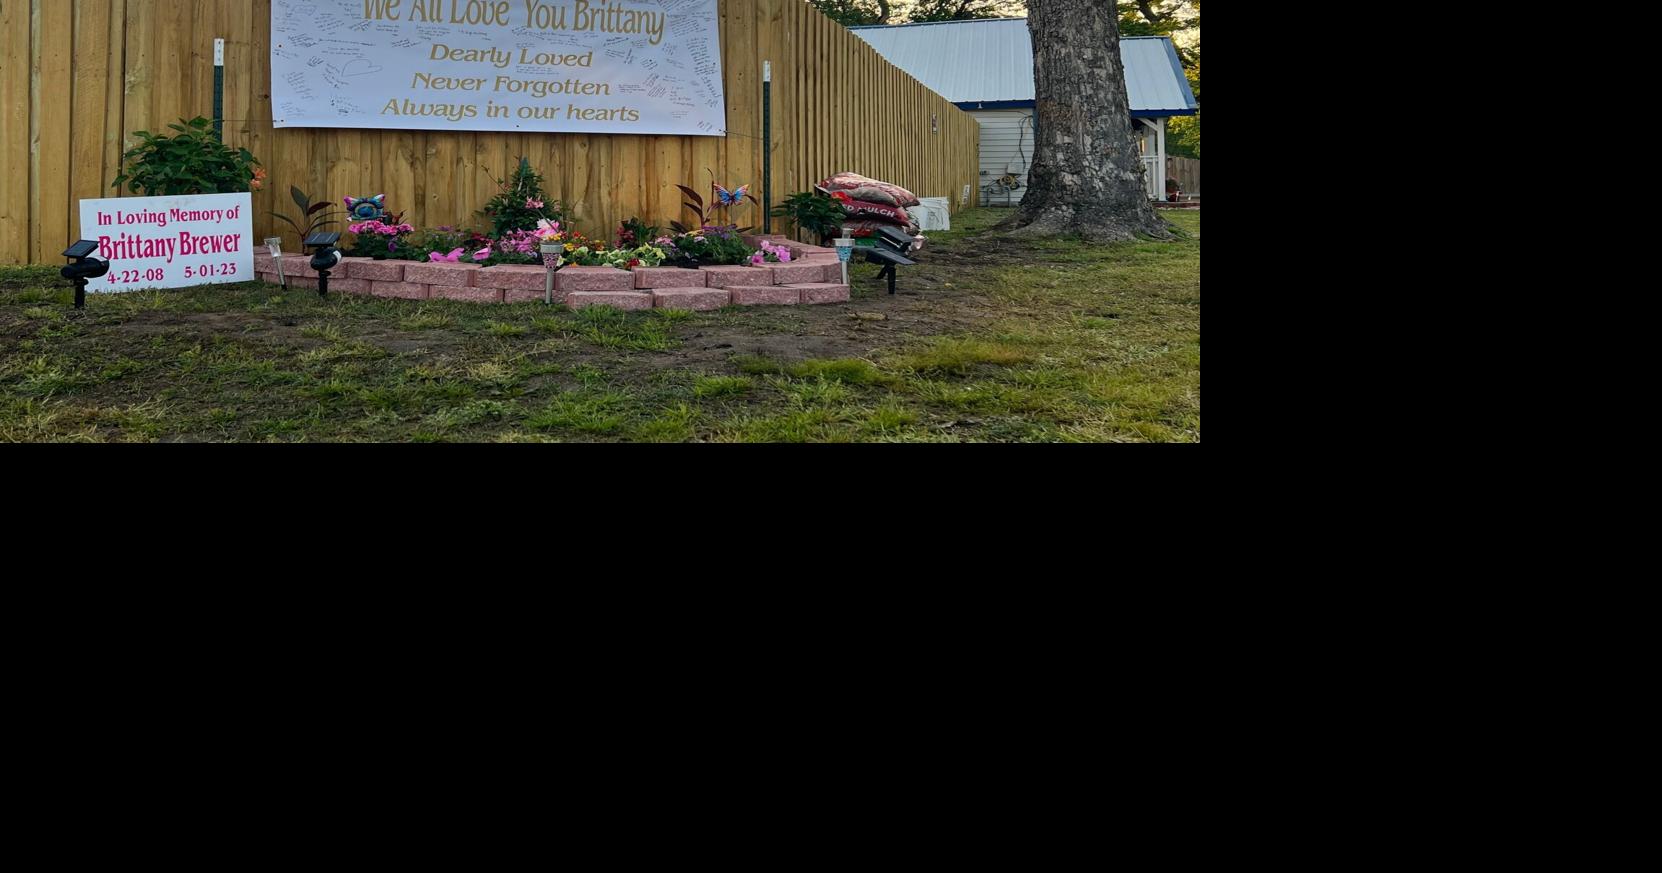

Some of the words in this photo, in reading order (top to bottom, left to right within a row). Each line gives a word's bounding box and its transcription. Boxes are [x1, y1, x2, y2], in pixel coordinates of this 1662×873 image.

[364, 0, 400, 21] We
[408, 0, 443, 24] All
[449, 0, 510, 26] Love
[525, 0, 566, 31] You
[573, 0, 666, 46] Brittany
[430, 43, 512, 69] Dearly
[518, 48, 593, 68] Loved
[411, 72, 487, 92] Never
[493, 75, 610, 98] Forgotten
[381, 98, 478, 122] Always
[486, 99, 510, 119] in
[517, 104, 560, 120] our
[566, 103, 640, 122] hearts
[97, 211, 112, 226] In
[117, 208, 167, 227] Loving
[170, 207, 223, 224] Memory
[227, 205, 241, 219] of
[98, 232, 176, 263] Brittany
[179, 231, 241, 256] Brewer
